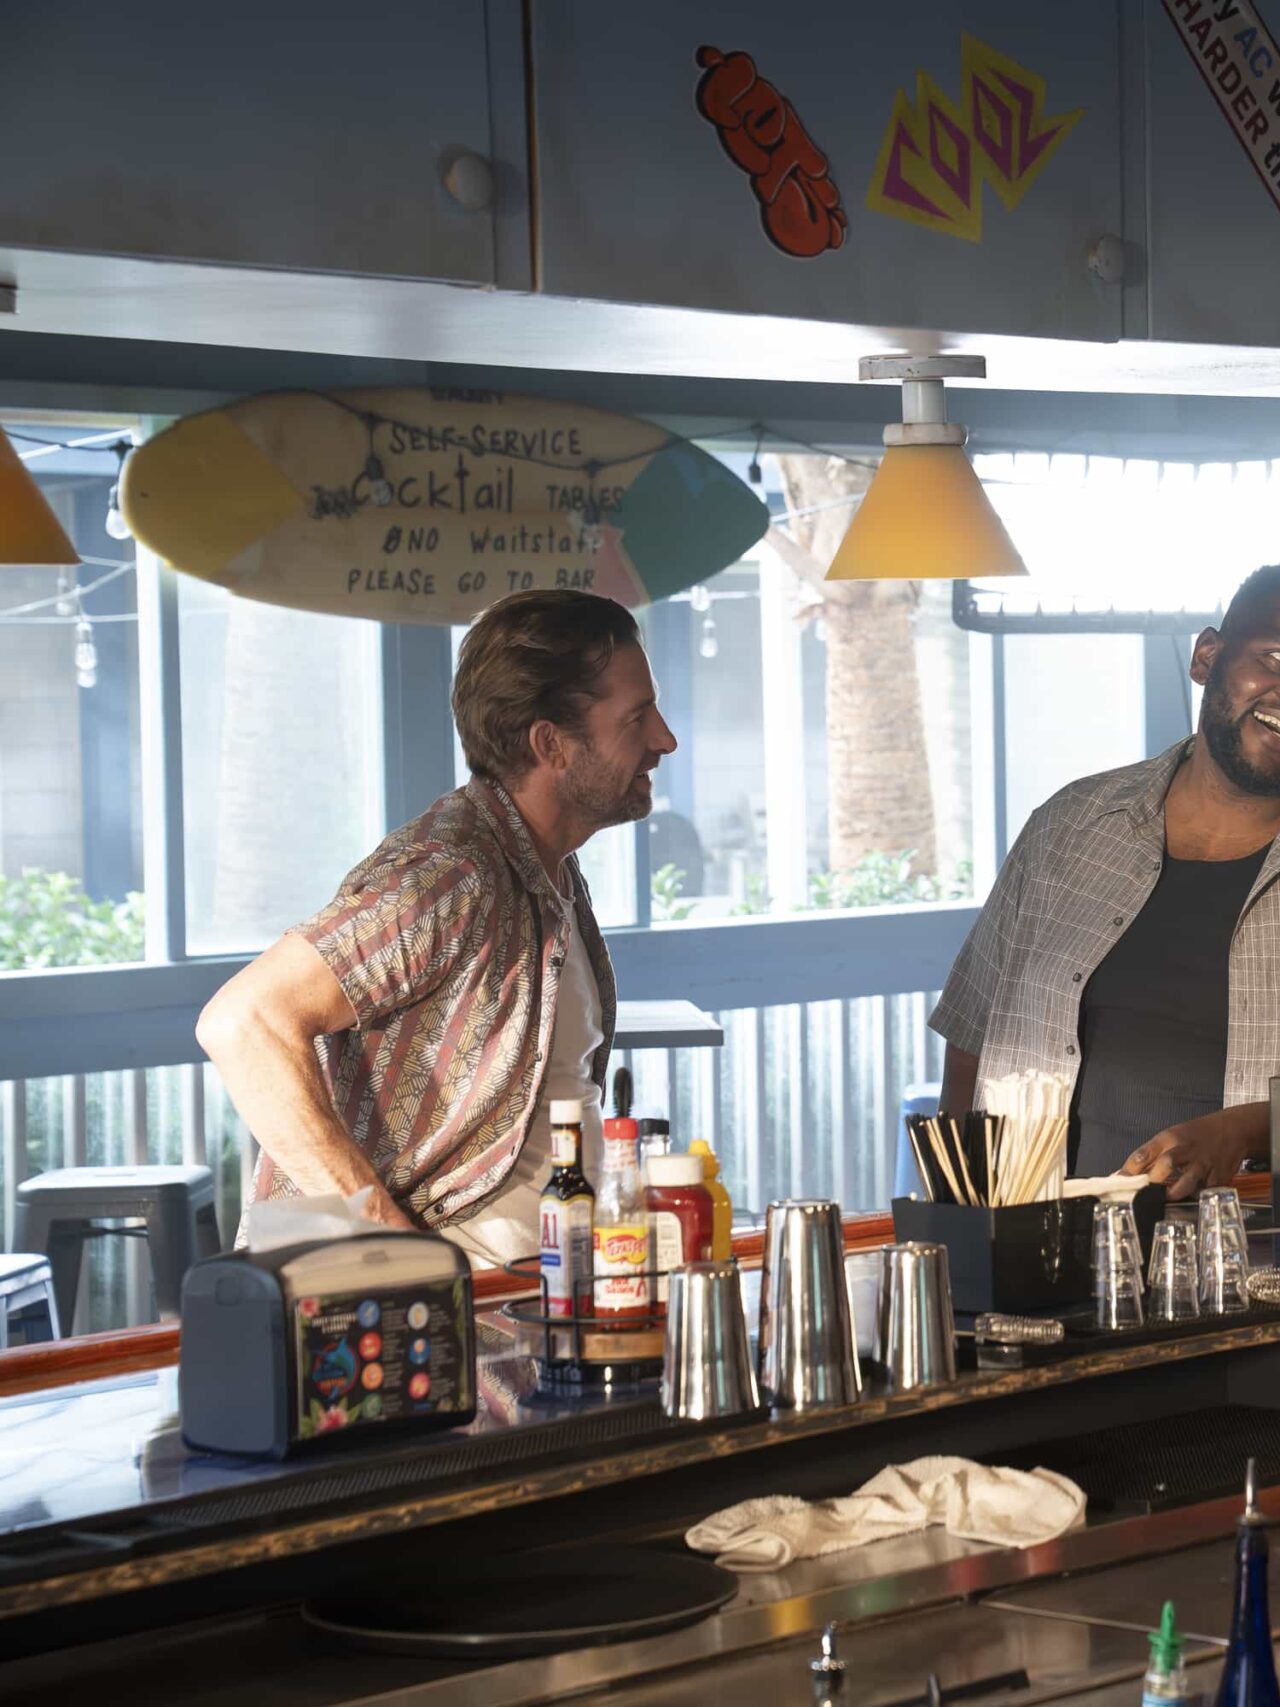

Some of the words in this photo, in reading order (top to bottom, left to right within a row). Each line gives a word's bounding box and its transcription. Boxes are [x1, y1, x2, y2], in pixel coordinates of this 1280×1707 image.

[1233, 27, 1272, 78] AC
[1175, 0, 1269, 145] HARDER
[388, 420, 583, 457] SELF-SERVICE
[470, 524, 598, 554] Waitstaf
[348, 568, 437, 596] PLEASE
[457, 571, 486, 594] GO
[507, 570, 533, 592] TO
[553, 568, 597, 593] BAR
